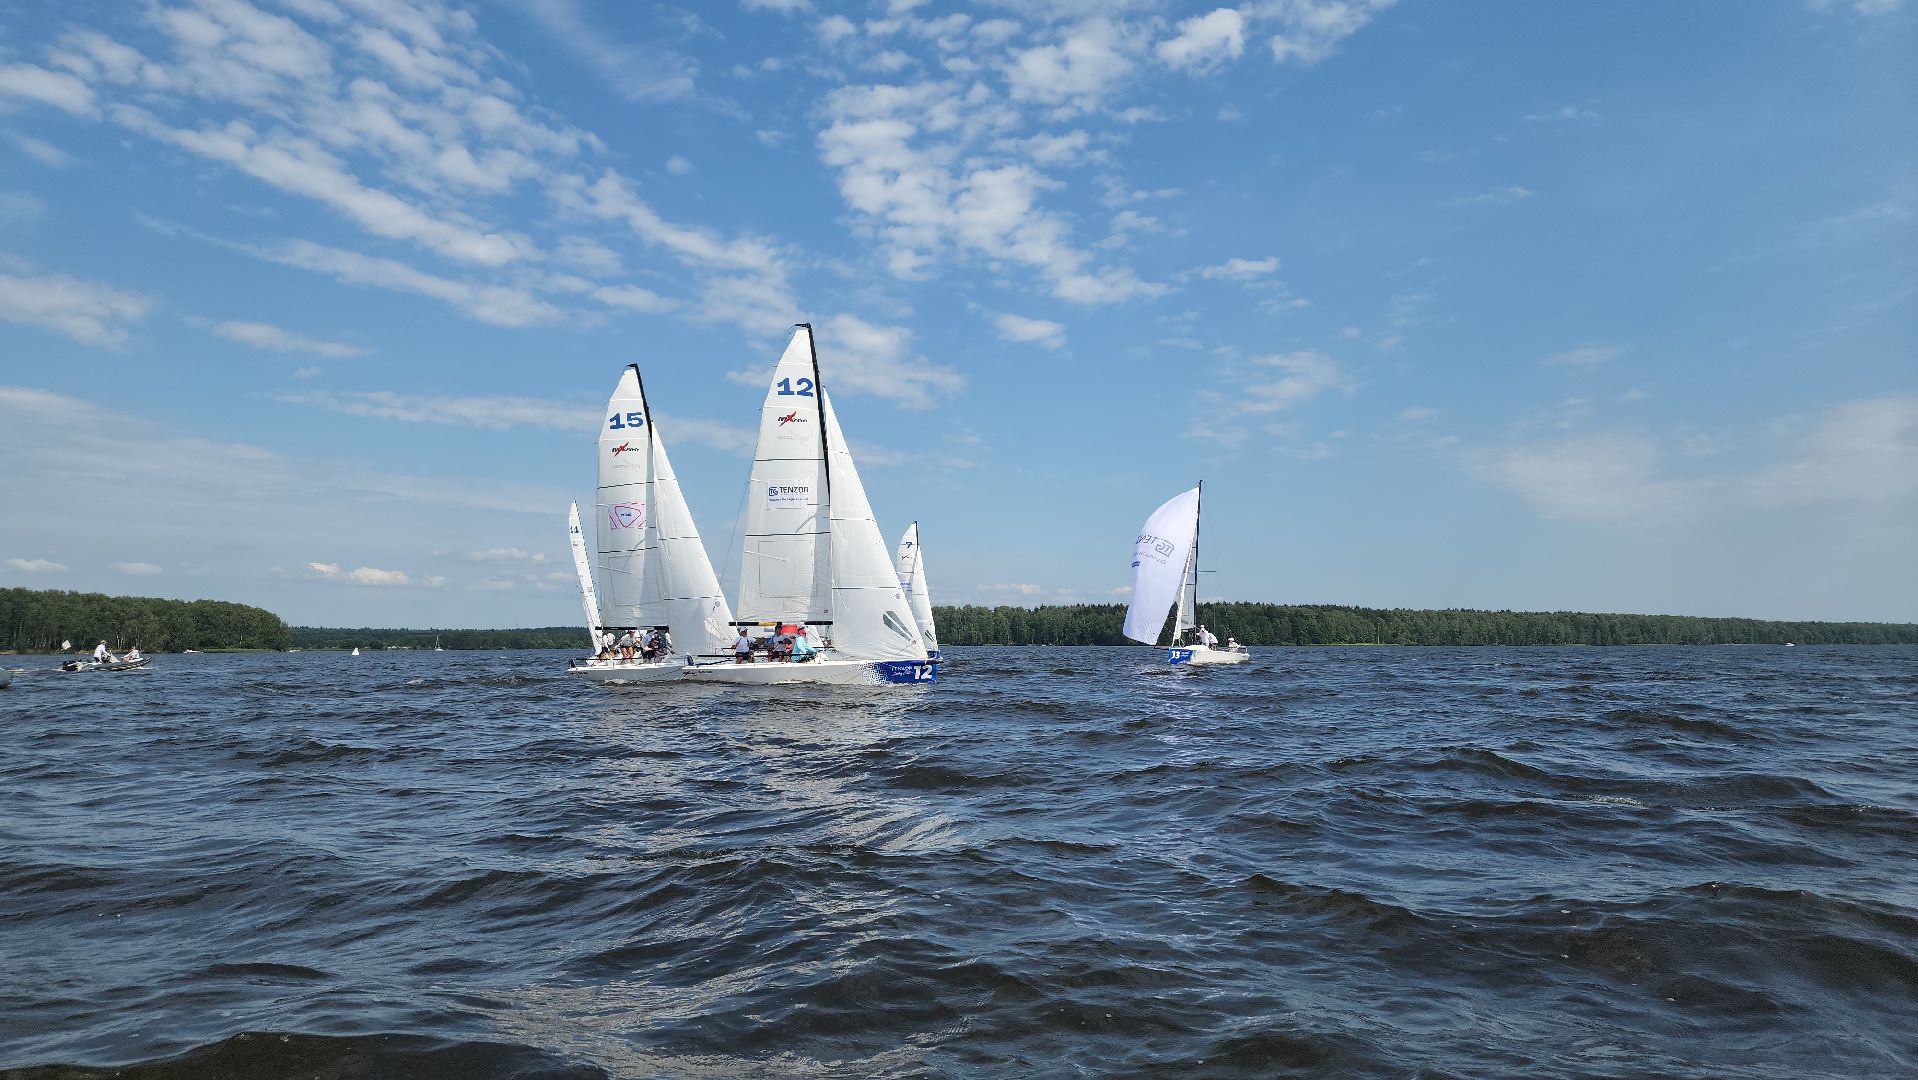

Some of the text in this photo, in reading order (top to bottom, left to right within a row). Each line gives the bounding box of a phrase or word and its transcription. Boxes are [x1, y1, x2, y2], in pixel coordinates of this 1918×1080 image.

[777, 377, 814, 398] 12
[609, 411, 644, 430] 15
[905, 541, 913, 549] 7
[913, 664, 933, 680] 12
